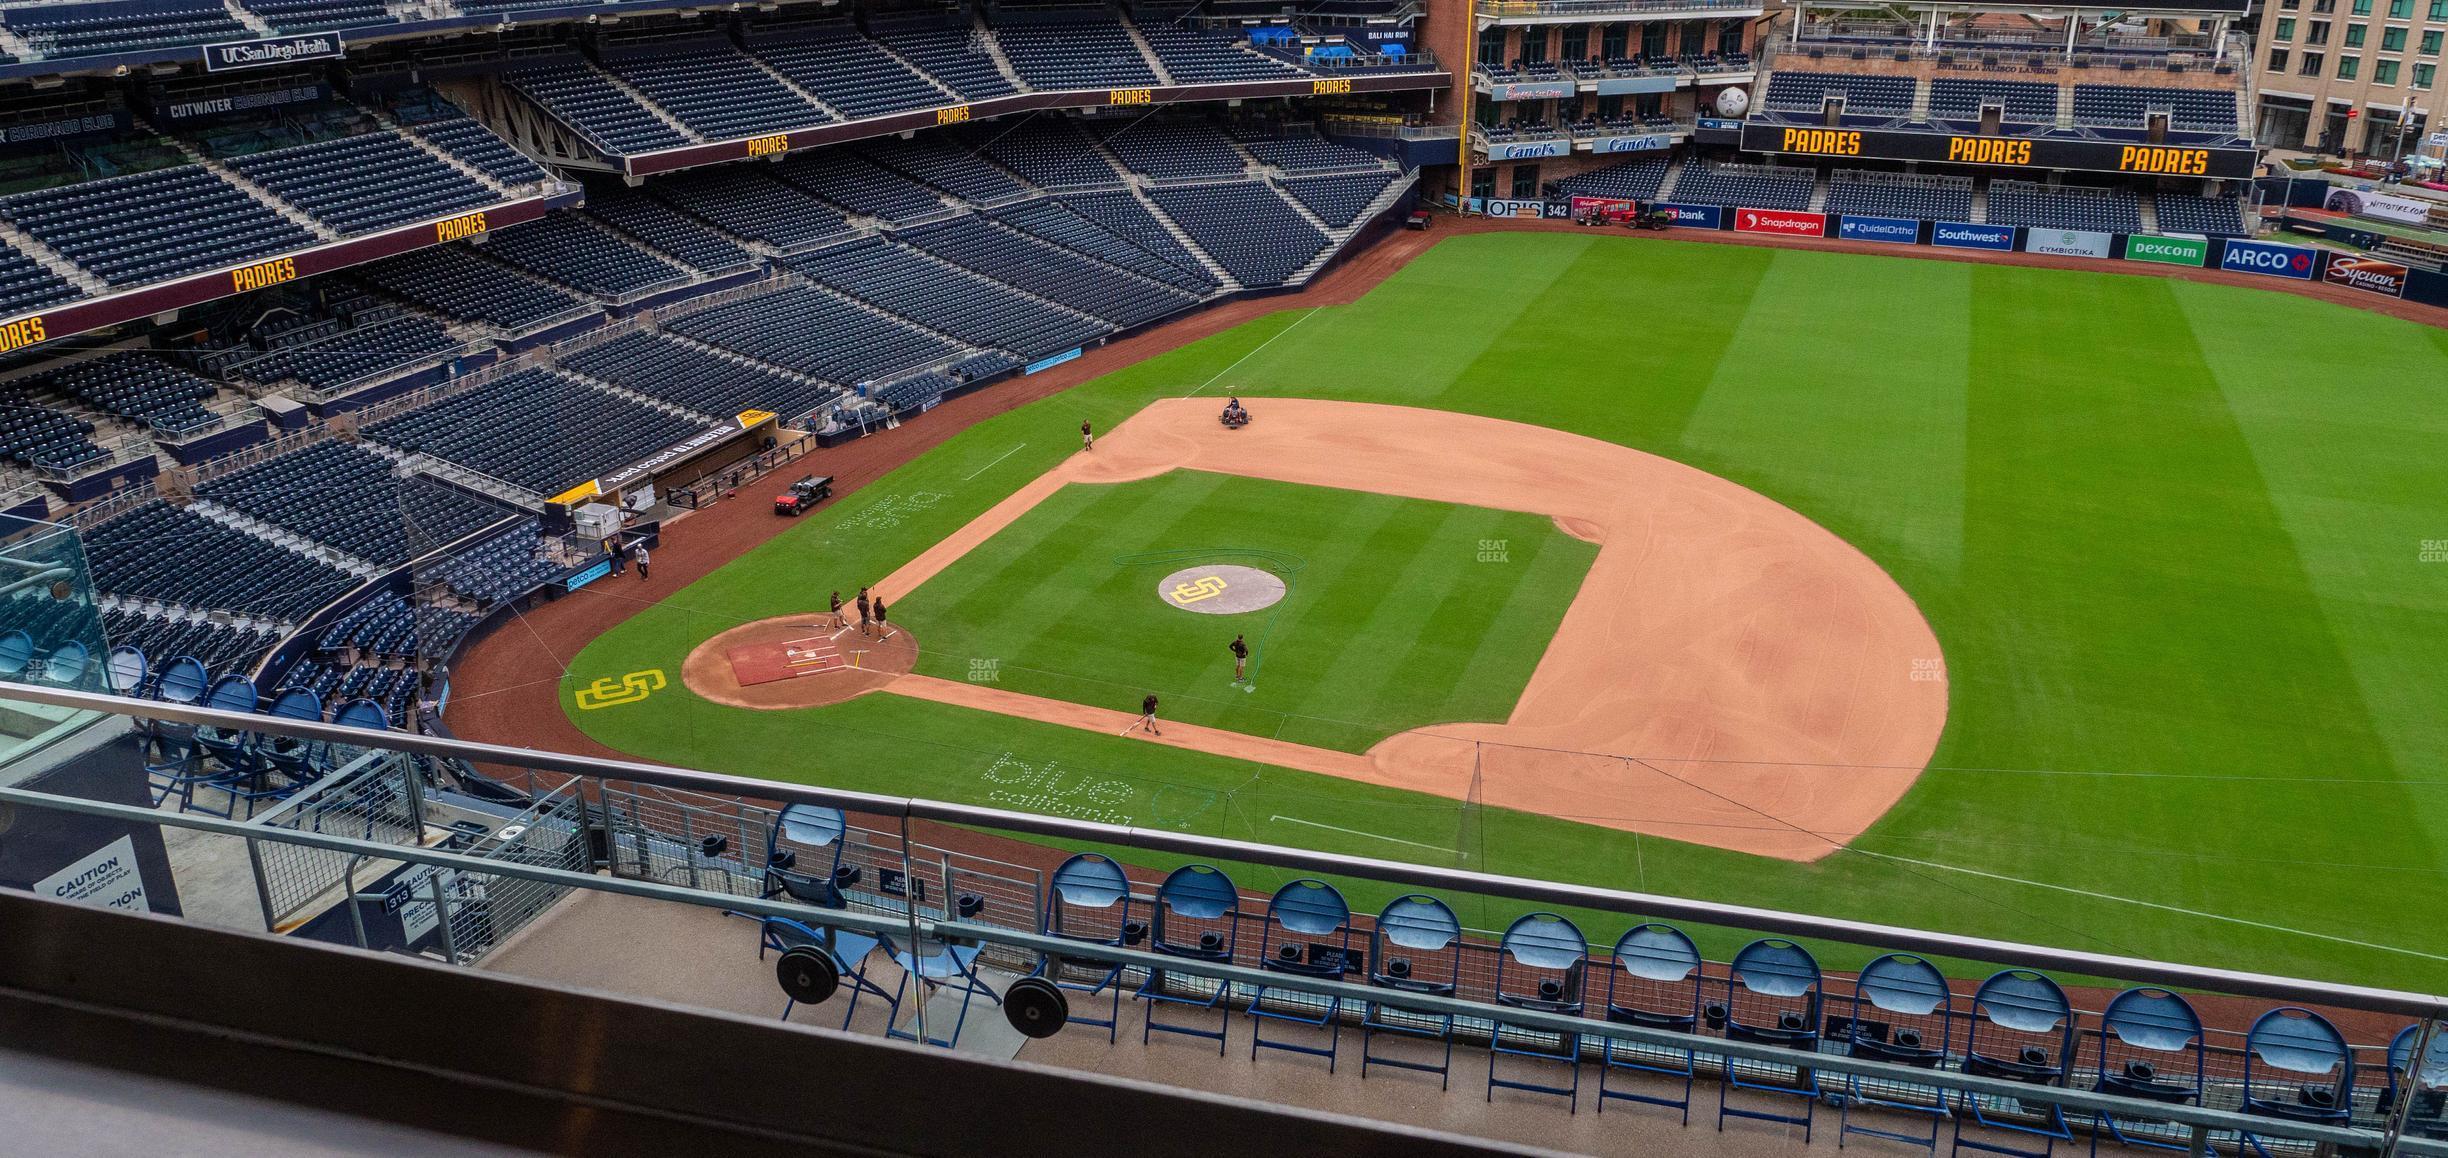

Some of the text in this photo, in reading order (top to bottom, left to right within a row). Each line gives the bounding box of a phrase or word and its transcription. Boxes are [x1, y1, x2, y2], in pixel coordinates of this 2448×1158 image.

[1383, 31, 1394, 39] HAI
[220, 39, 331, 63] UC San Diego Health
[2018, 67, 2058, 75] LANDING
[1314, 80, 1351, 94] PADRES
[1110, 88, 1151, 105] PADRES
[170, 98, 232, 118] CUTWATER
[937, 106, 969, 125] PADRES
[9, 119, 81, 142] CORONADO
[81, 114, 115, 132] CLUB
[748, 135, 788, 157] PADRES
[1608, 136, 1657, 152] Canel's
[1783, 128, 1861, 155] PADRES
[1505, 143, 1555, 159] Canel's
[1949, 137, 2032, 165] PADRES
[2119, 146, 2208, 175] PADRES
[2365, 160, 2386, 168] petco
[1548, 205, 1566, 217] 342
[1678, 210, 1705, 221] bank
[2369, 200, 2427, 216] NITTOTIRE.COM
[436, 213, 486, 242] PADRES
[1760, 216, 1819, 230] Snapdragon
[1858, 223, 1914, 235] QuidelOrtho
[1938, 228, 2000, 243] Southwest
[2039, 246, 2094, 256] CYMBIOTIKA
[2225, 248, 2288, 269] ARCO
[232, 258, 296, 293] PADRES
[2329, 257, 2396, 286] Sycuan
[2355, 279, 2397, 294] CASINO RESORT
[688, 425, 736, 448] WELCOME
[640, 450, 674, 471] petco
[605, 467, 641, 484] park
[568, 573, 589, 588] petco
[981, 752, 1133, 805] blue
[56, 857, 118, 897] CAUTION
[90, 883, 106, 895] FIELD
[107, 879, 116, 887] OF
[117, 869, 131, 881] PLAY
[96, 867, 123, 884] OBJECTS
[389, 889, 409, 909] 313
